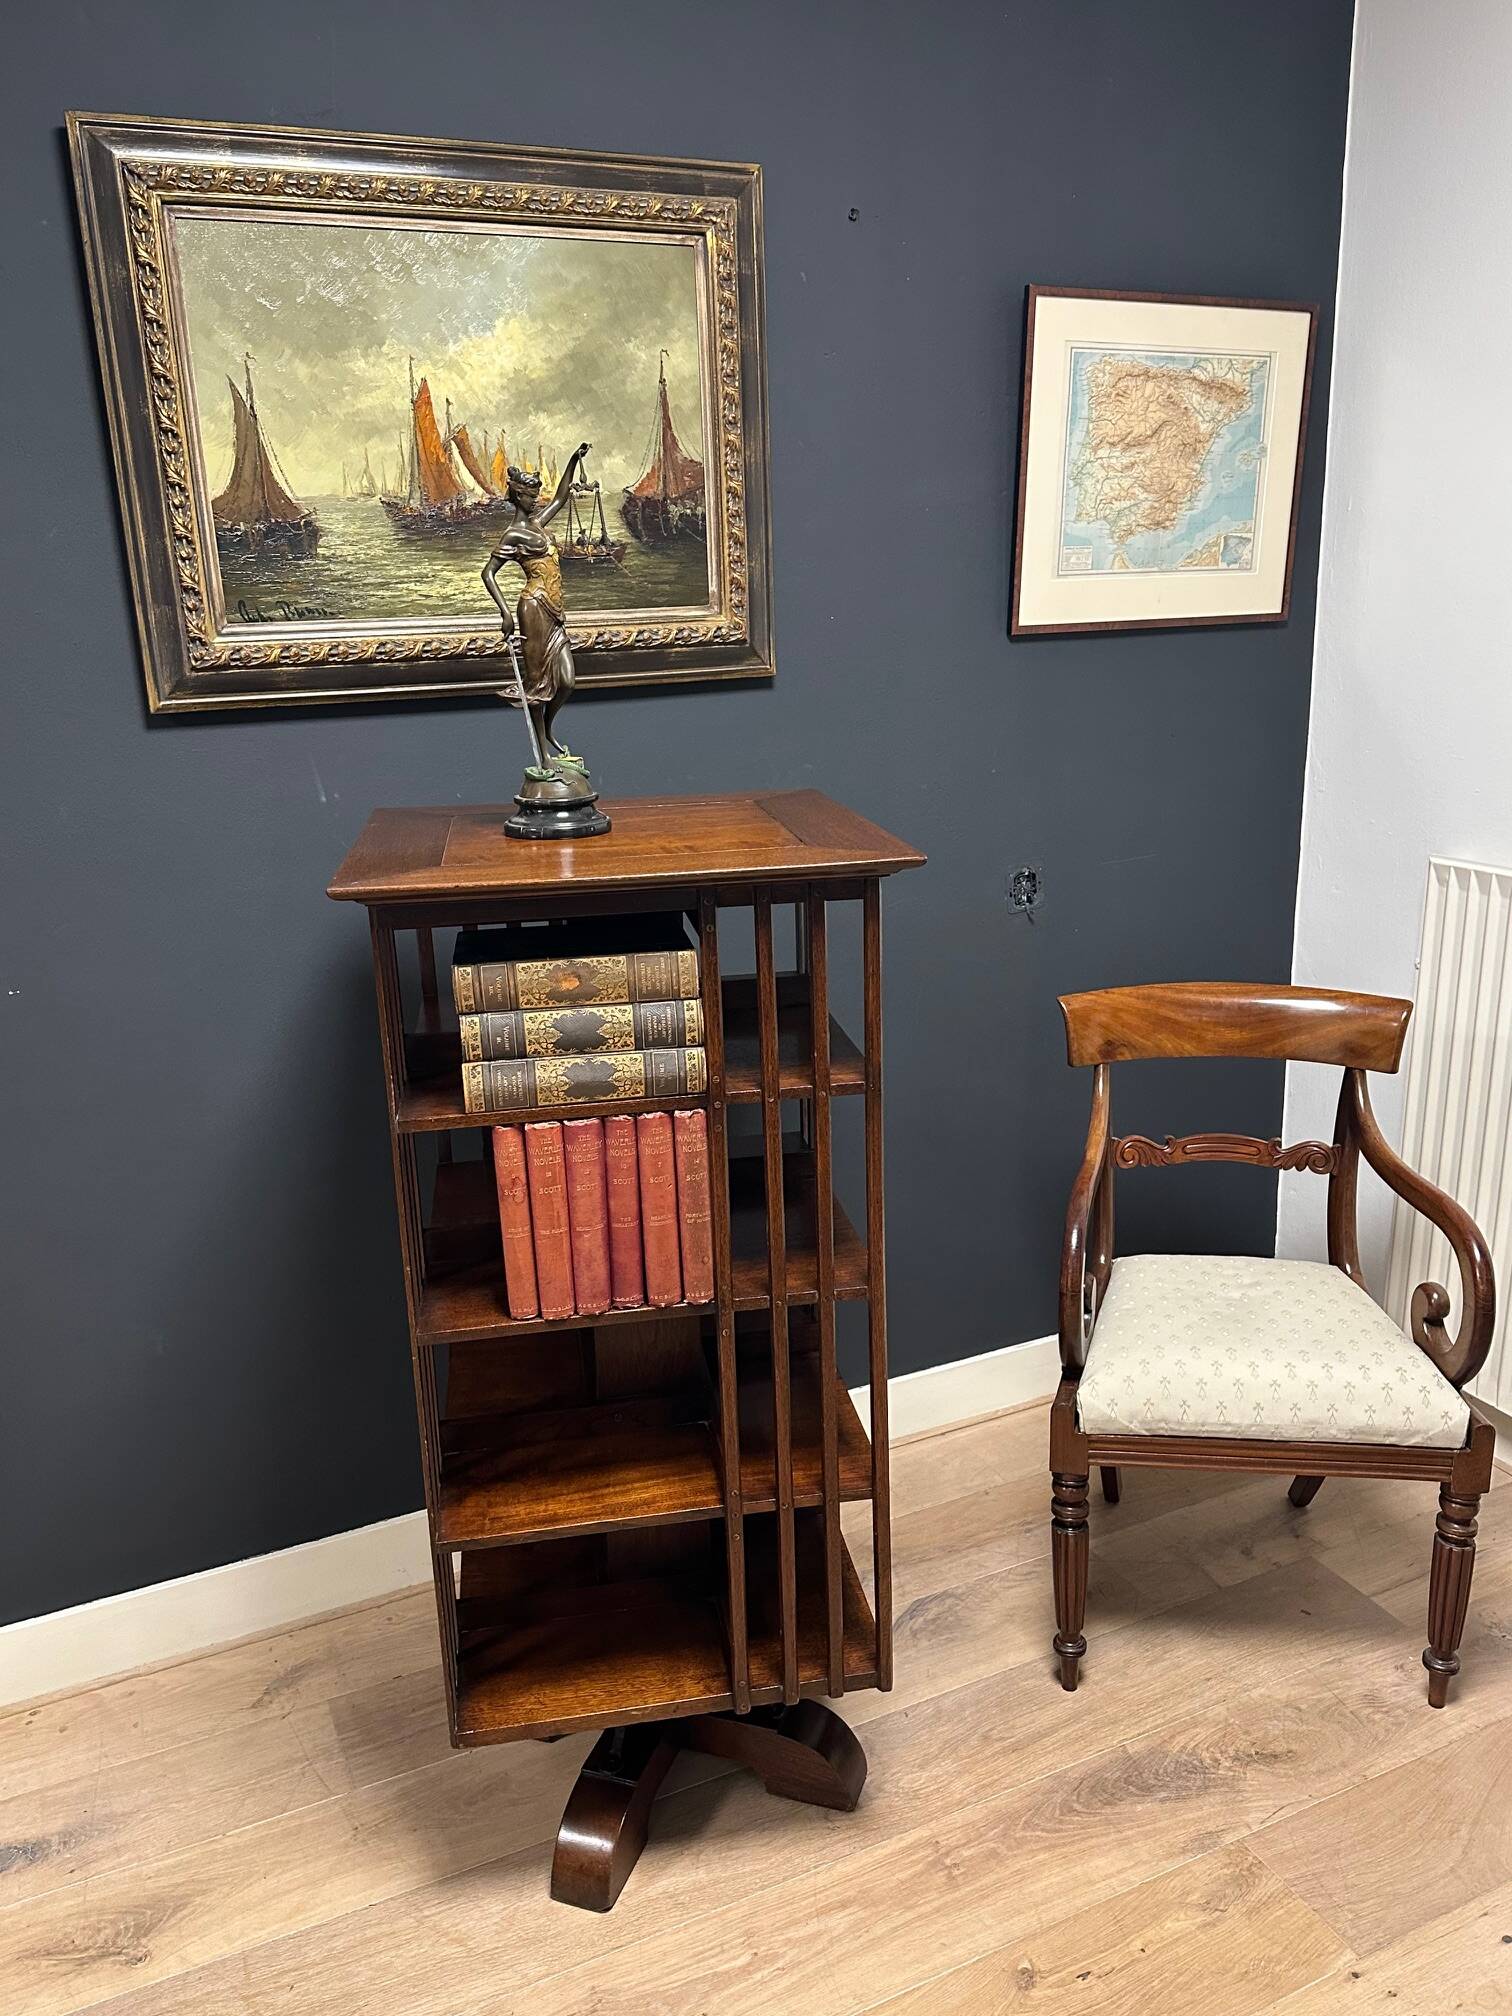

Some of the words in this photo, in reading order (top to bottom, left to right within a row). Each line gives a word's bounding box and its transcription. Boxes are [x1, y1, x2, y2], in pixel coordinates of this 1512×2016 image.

[682, 1142, 708, 1153] NOVELS
[534, 1156, 561, 1166] NOVELS
[613, 1176, 635, 1185] SCOTT
[686, 1172, 707, 1182] SCOTT
[539, 1184, 562, 1195] SCOTT
